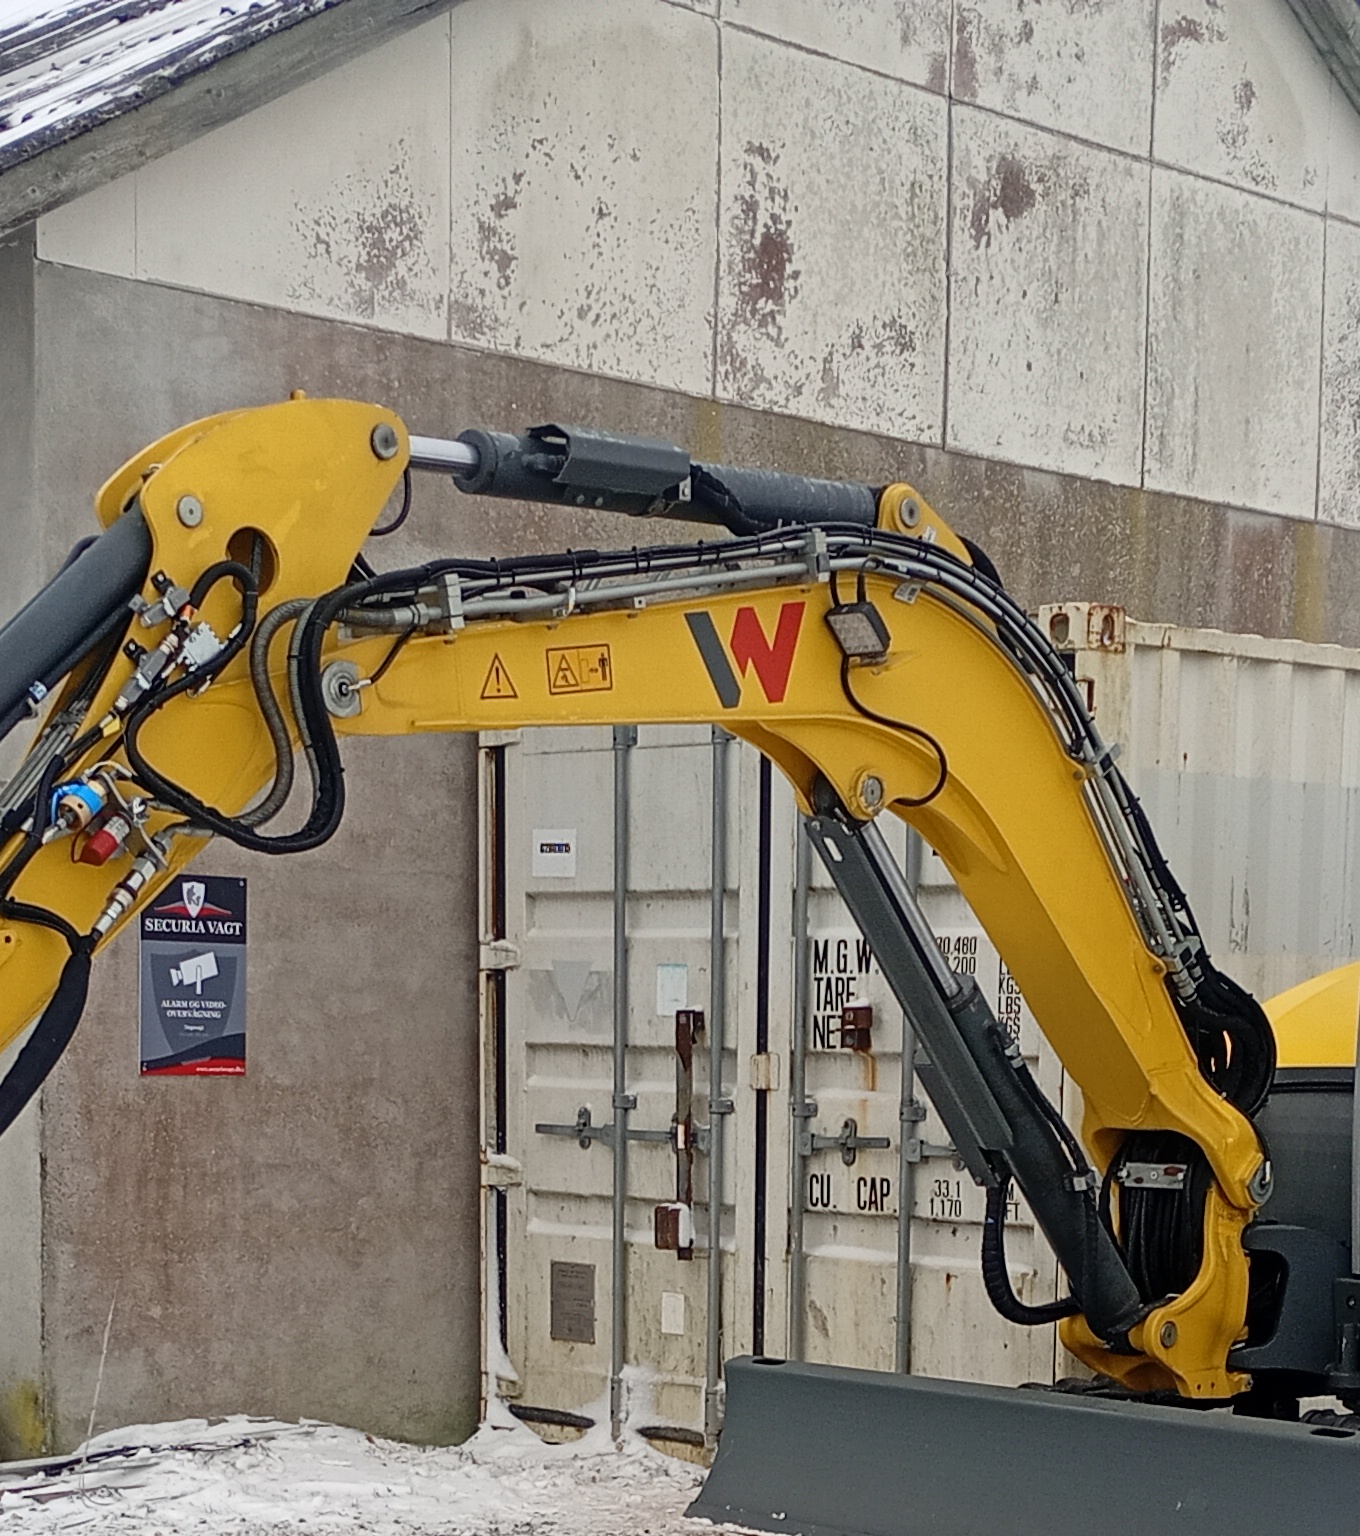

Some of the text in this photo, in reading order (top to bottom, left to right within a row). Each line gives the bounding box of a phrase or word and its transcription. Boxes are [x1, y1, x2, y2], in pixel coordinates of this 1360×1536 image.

[145, 918, 243, 935] SECURIA VAGT
[813, 937, 880, 976] M.G.W.
[998, 996, 1021, 1015] LBS
[809, 1173, 837, 1209] CU.
[856, 1177, 898, 1213] CAP.
[934, 1179, 962, 1198] 33.1
[930, 1198, 962, 1218] 1.170
